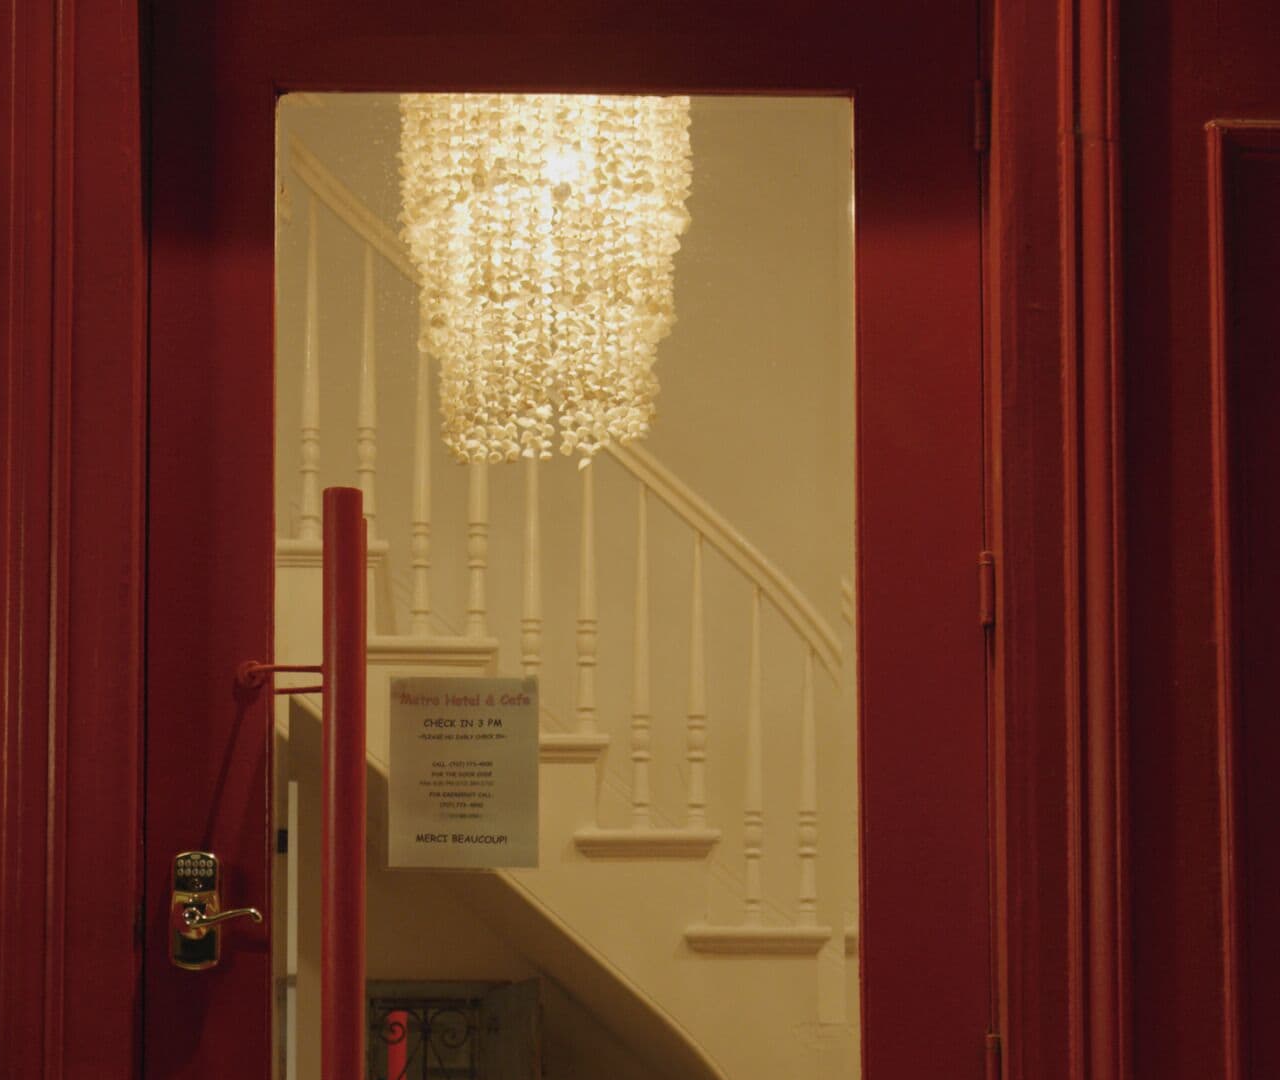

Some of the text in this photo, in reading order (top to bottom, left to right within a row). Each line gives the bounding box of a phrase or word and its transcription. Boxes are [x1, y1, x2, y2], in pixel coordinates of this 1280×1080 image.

[423, 719, 456, 728] CHECK
[460, 719, 473, 728] IN
[487, 719, 503, 728] PM
[416, 834, 507, 844] MERCI BEAUCOUP!
